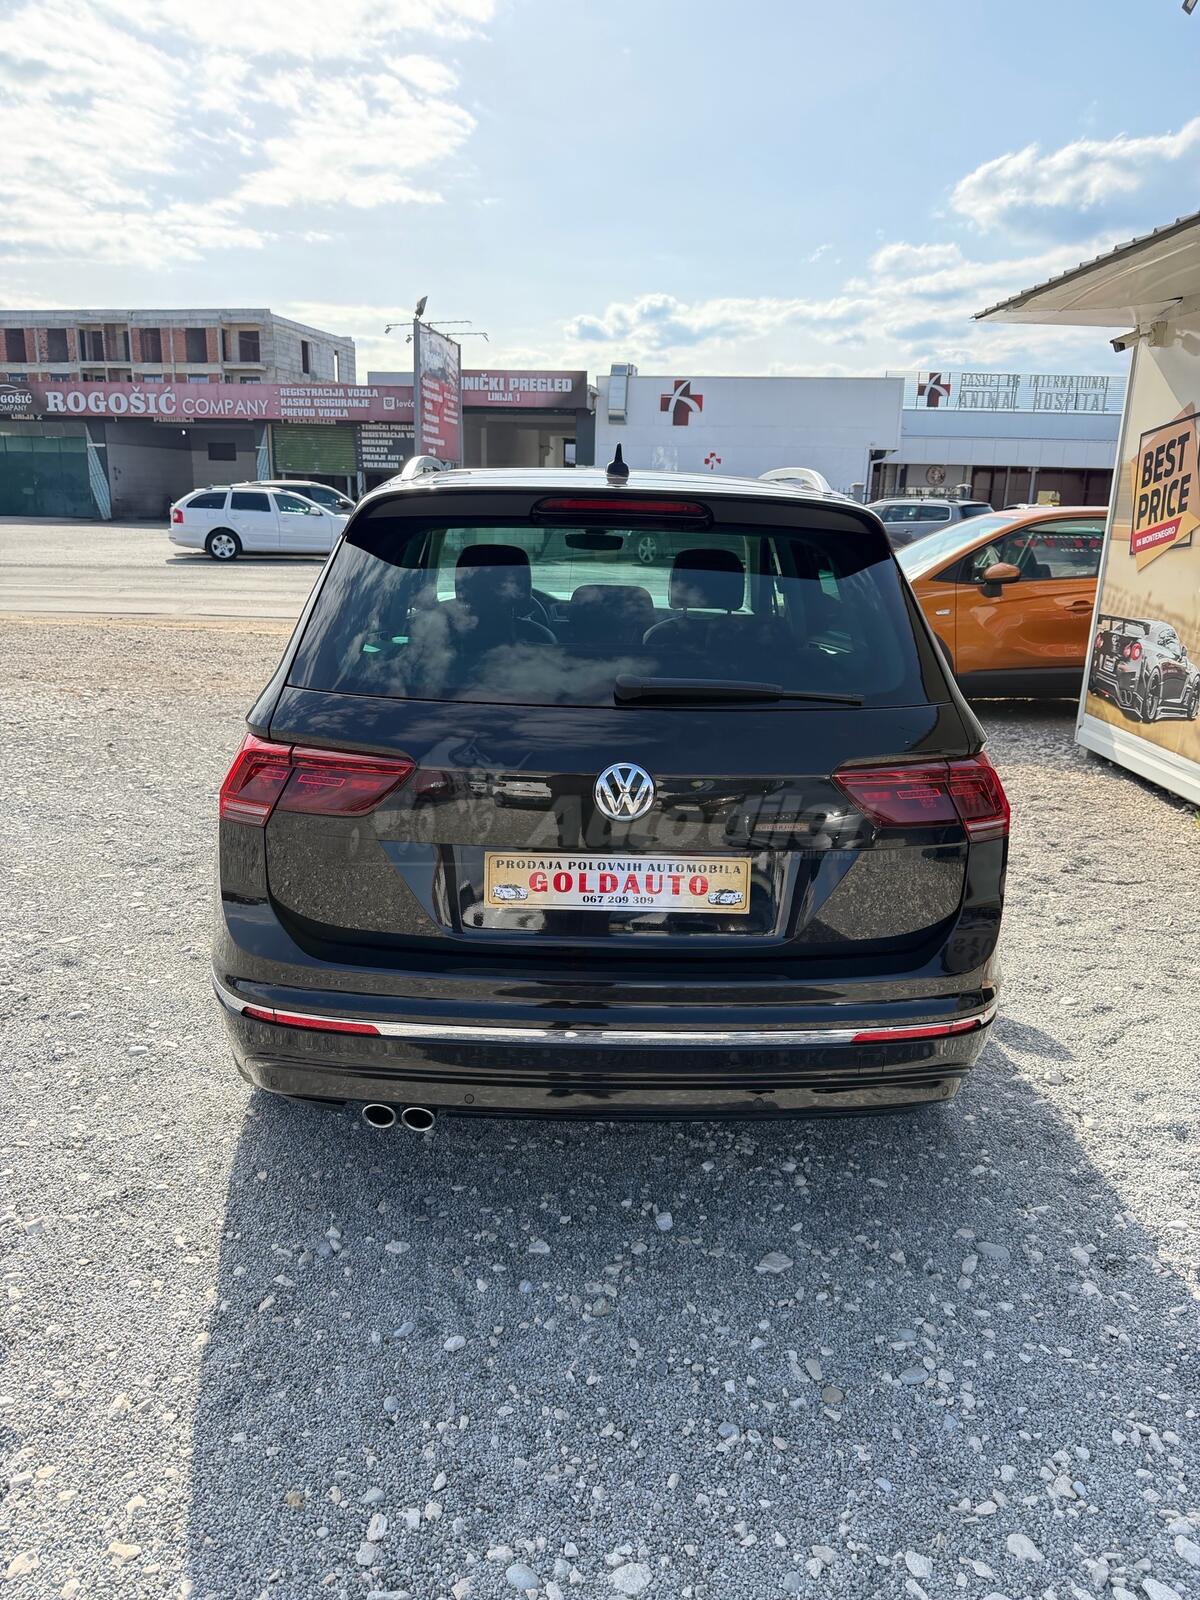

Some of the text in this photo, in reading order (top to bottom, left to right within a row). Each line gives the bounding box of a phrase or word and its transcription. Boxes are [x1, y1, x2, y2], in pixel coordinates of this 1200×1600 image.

[509, 378, 573, 392] PREGLED
[1029, 374, 1111, 389] INTERNATIONAL
[280, 387, 379, 398] REGISTRACIJA VOZILA
[488, 392, 521, 402] LINIJA 1
[959, 390, 1110, 411] ANIMAL HOSPITAL
[46, 386, 269, 416] ROGOŠIĆ COMPANY
[280, 398, 371, 408] KASKO OSIGURANJE
[281, 408, 349, 417] PREVOD VOZILA
[1141, 431, 1191, 489] BEST
[1136, 473, 1192, 530] PRICE
[1142, 526, 1176, 545] MONTENEGRO
[496, 859, 742, 876] PRODAJA POLOVNIH AUTOMOBILA
[528, 871, 710, 896] GOLDAUTO
[582, 894, 655, 906] 067 209 309
